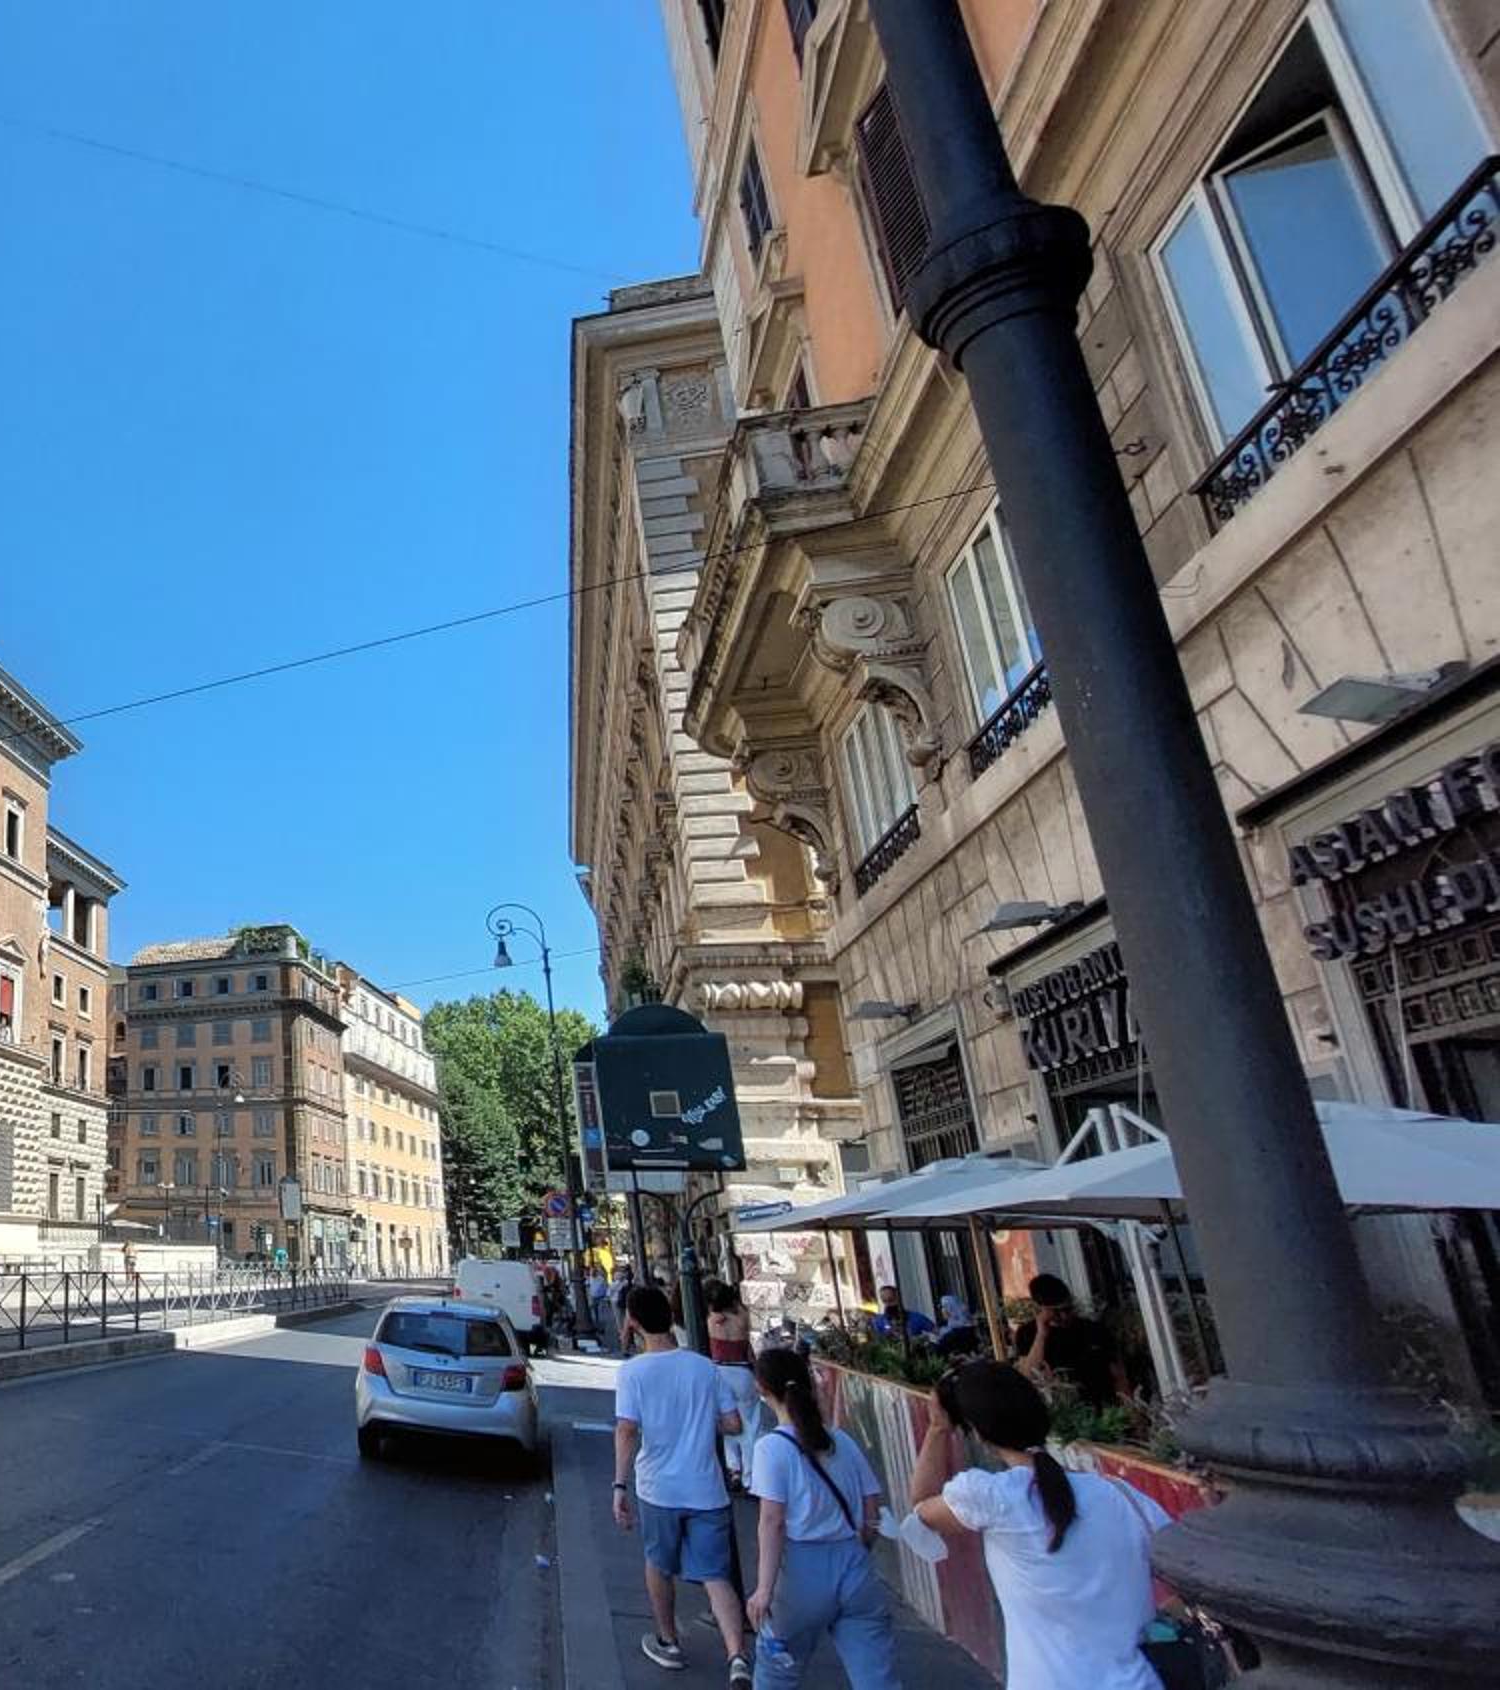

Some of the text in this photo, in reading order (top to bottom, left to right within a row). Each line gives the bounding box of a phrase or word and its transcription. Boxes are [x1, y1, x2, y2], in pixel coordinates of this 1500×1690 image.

[1288, 782, 1446, 888] ASIAN
[1011, 940, 1125, 1020] RISTORANT
[1021, 986, 1140, 1072] KURIY
